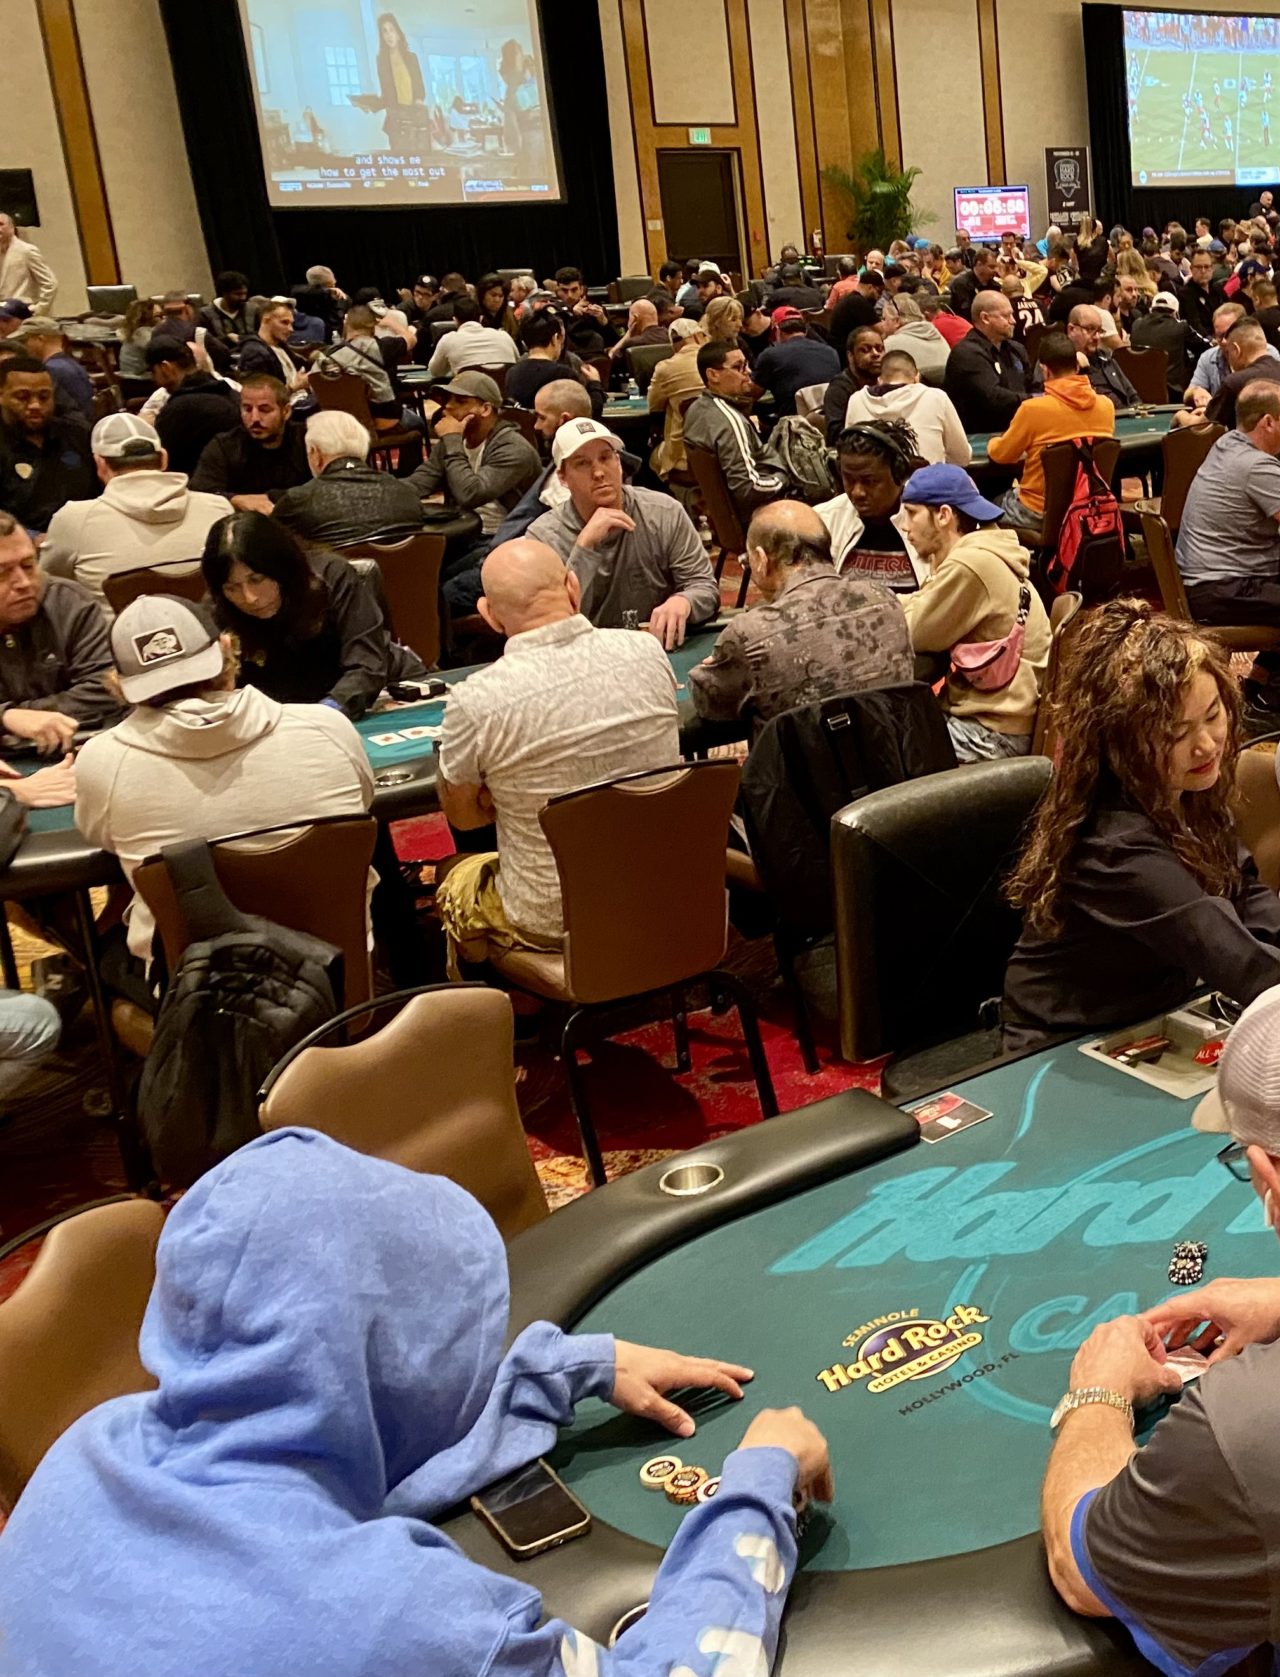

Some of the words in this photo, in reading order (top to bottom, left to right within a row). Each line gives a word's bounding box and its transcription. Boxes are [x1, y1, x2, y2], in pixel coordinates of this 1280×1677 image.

[320, 168, 339, 177] how
[344, 168, 356, 177] to
[360, 168, 377, 178] get
[382, 167, 399, 177] the
[402, 167, 425, 177] most
[429, 167, 446, 177] out
[355, 155, 373, 165] and
[377, 155, 405, 165] shows
[409, 156, 421, 165] me
[815, 1337, 907, 1392] Hard
[900, 1303, 993, 1351] Rock
[842, 1307, 920, 1348] SEMINOLE
[872, 1365, 917, 1390] HOTEL
[916, 1358, 929, 1369] &
[928, 1335, 978, 1365] CASINO
[897, 1361, 1004, 1417] HOLLYWOOD,
[1003, 1351, 1021, 1364] FL
